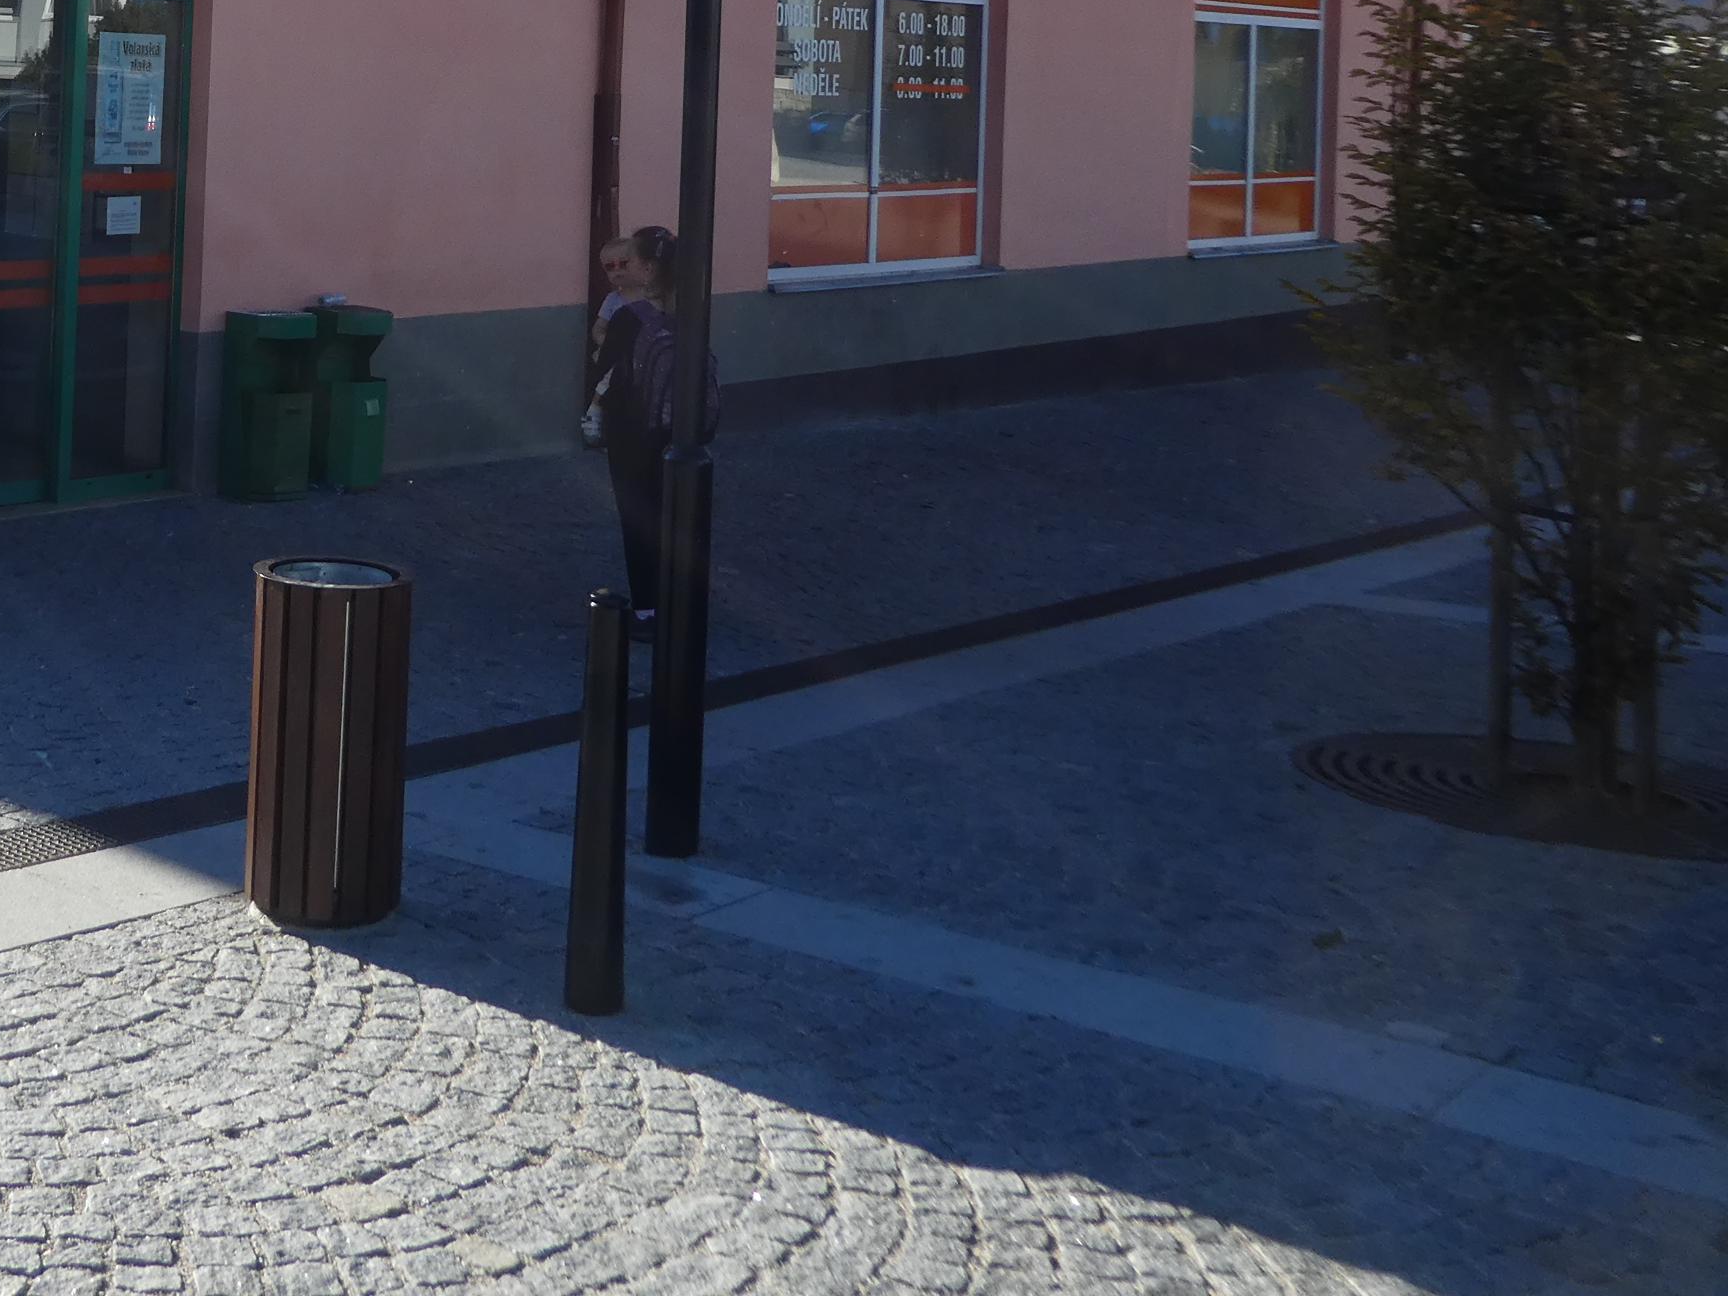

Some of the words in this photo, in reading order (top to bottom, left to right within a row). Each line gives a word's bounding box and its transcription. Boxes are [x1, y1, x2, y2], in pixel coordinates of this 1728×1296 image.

[776, 0, 822, 29] ONDĚLÍ
[832, 2, 868, 30] PÁTEK
[898, 12, 924, 35] 6.00
[934, 14, 965, 36] 18.00
[793, 39, 841, 63] SOBOTA
[898, 45, 922, 67] 7.00
[934, 46, 965, 68] 11.00
[793, 68, 839, 96] NEDĚLE
